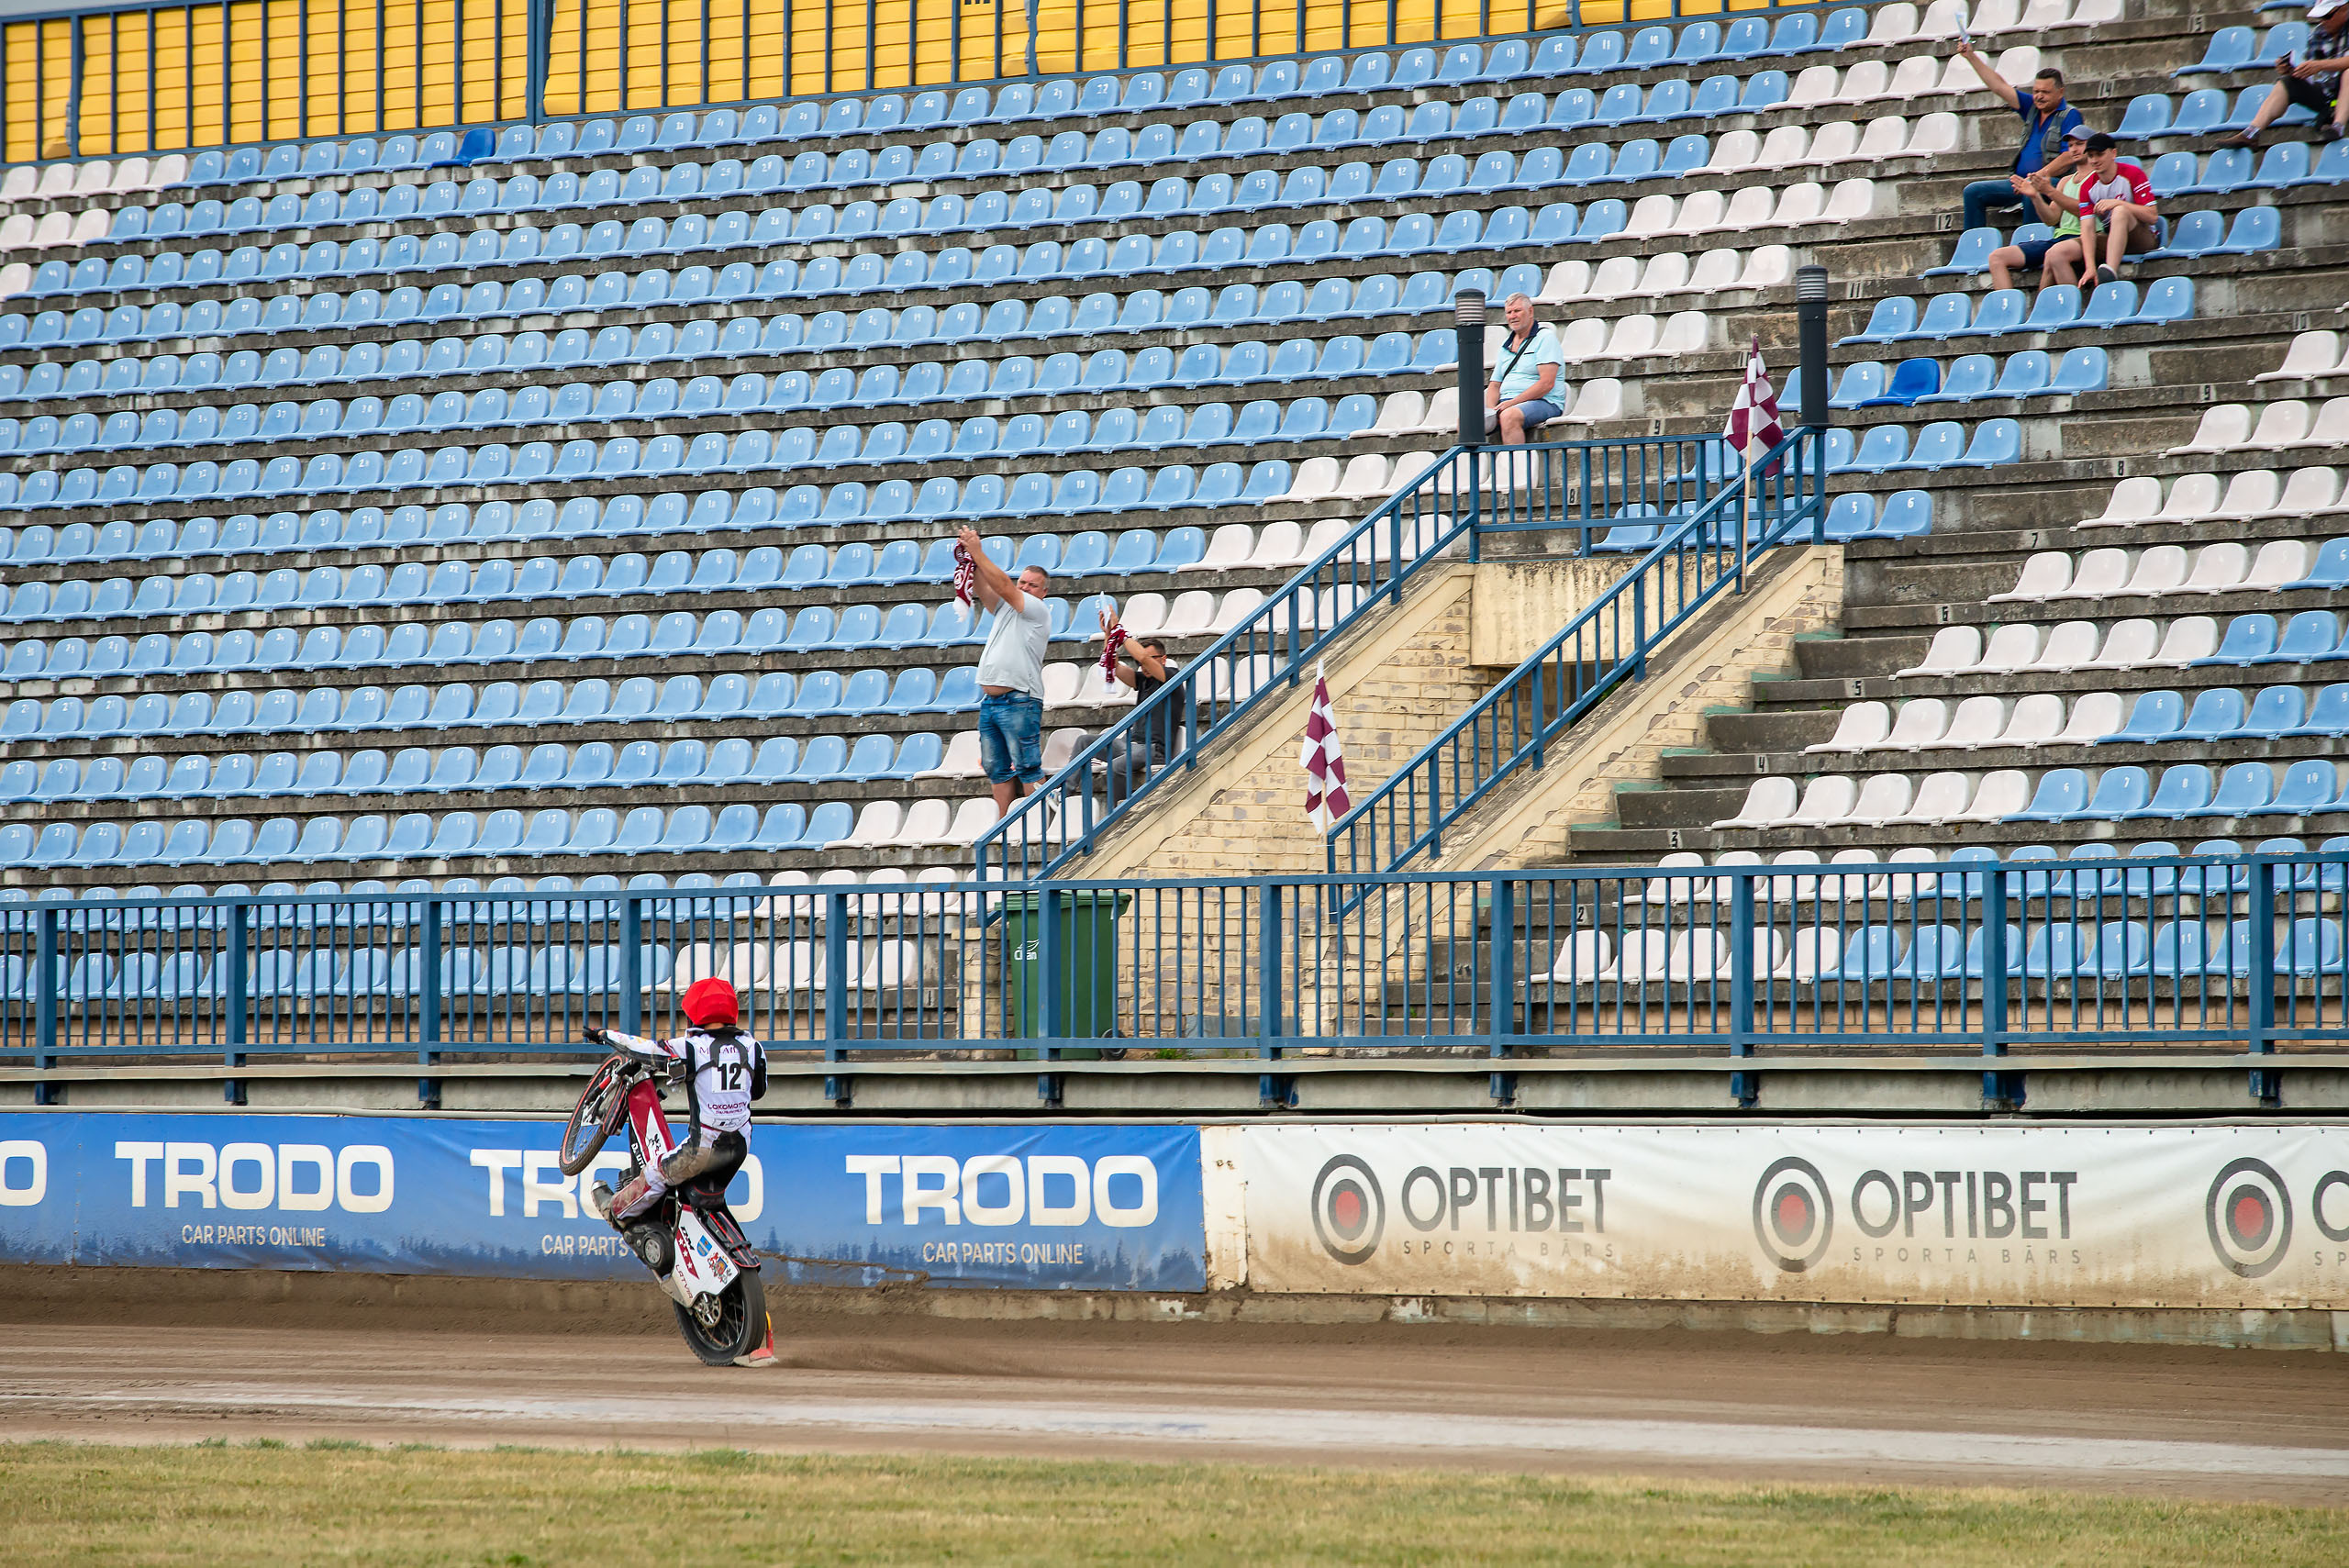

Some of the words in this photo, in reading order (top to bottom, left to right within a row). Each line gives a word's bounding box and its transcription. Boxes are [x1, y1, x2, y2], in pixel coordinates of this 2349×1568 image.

[1937, 214, 1952, 230] 12
[2117, 461, 2125, 476] 8
[1569, 488, 1575, 504] 8
[2031, 532, 2040, 549] 7
[1942, 606, 1949, 622] 6
[1854, 680, 1862, 696] 5
[1758, 756, 1765, 773] 4
[1671, 831, 1678, 848] 3
[1575, 906, 1585, 922] 2
[718, 1062, 741, 1091] 12
[115, 1140, 395, 1214] TRODO
[845, 1154, 1159, 1228] TRODO
[1401, 1165, 1611, 1234] OPTIBET
[1851, 1169, 2077, 1240] OPTIBET
[181, 1224, 215, 1244] CAR
[217, 1225, 266, 1246] PARTS
[269, 1227, 326, 1248] ONLINE
[540, 1234, 575, 1255] CAR
[578, 1235, 629, 1257] PARTS
[921, 1241, 958, 1263] CAR
[962, 1242, 1017, 1264] PARTS
[1020, 1242, 1085, 1265] ONLINE
[1403, 1240, 1516, 1255] SPORTA
[1540, 1239, 1615, 1257] BĀRS
[1854, 1247, 1977, 1263] SPORTA
[2002, 1245, 2081, 1264] BĀRS
[675, 1264, 694, 1299] LATVIA
